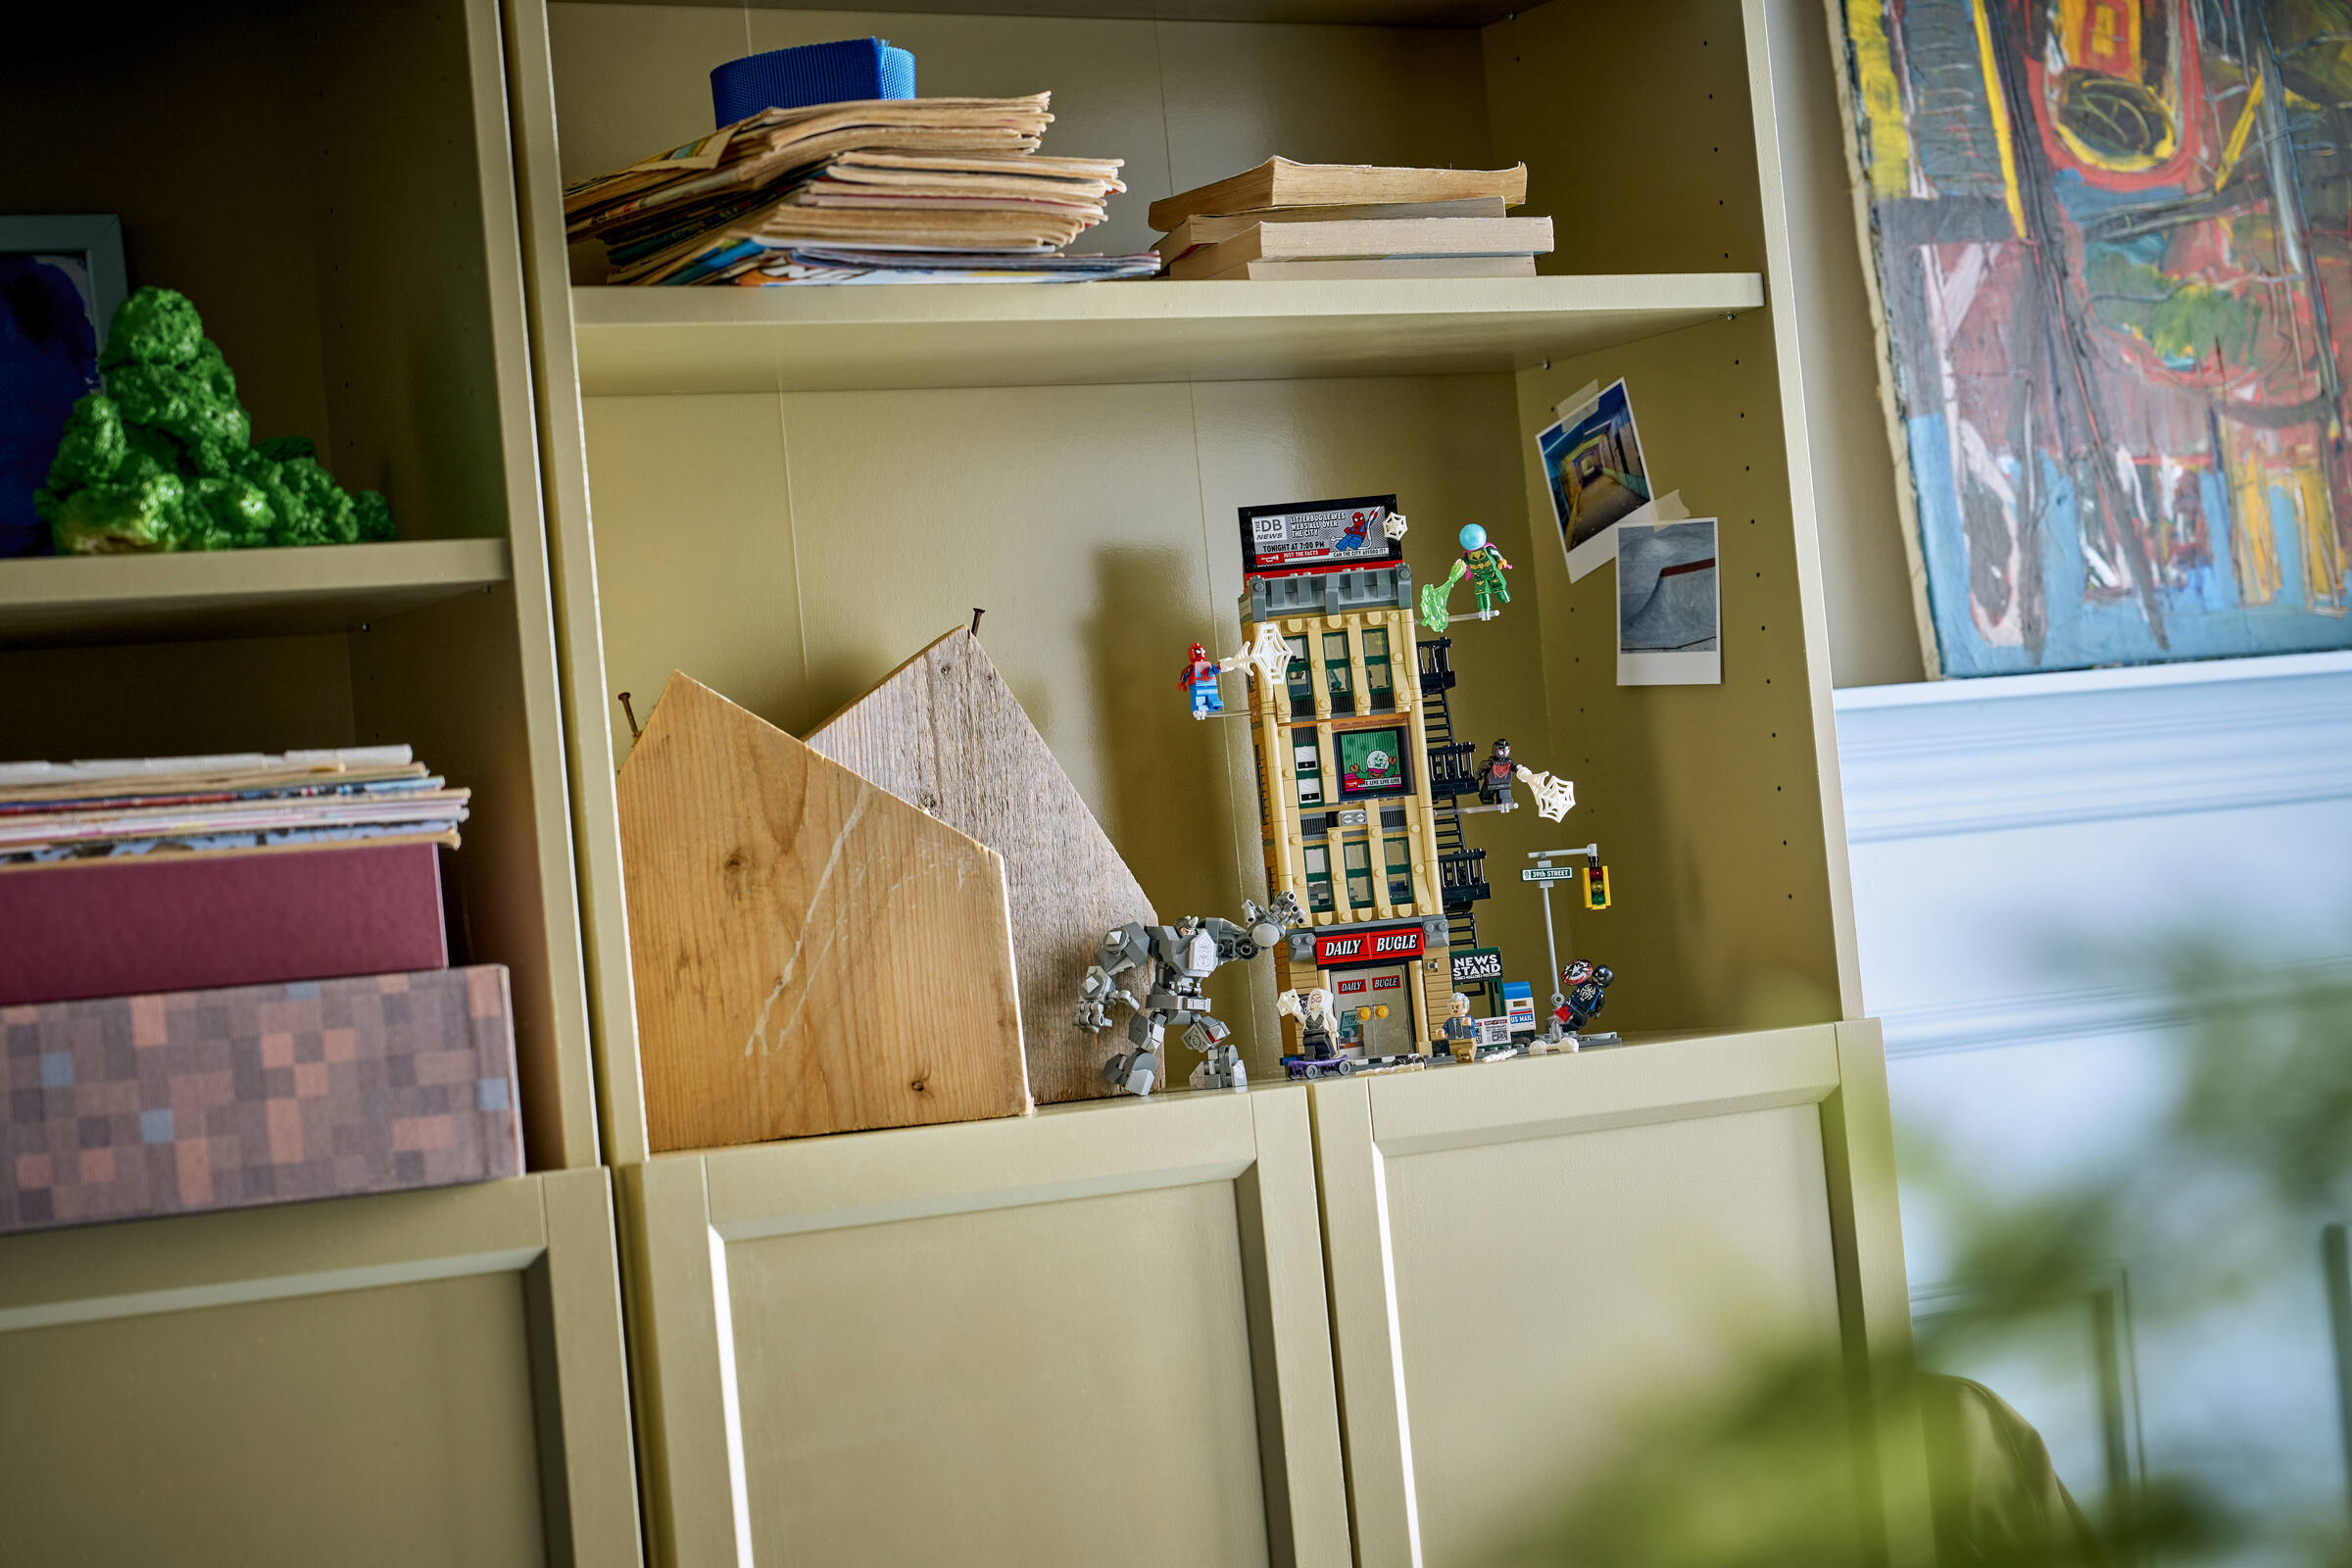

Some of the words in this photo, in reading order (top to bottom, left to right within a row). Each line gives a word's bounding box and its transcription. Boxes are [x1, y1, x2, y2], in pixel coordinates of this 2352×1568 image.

[1290, 514, 1323, 523] LITTERBUG
[1324, 512, 1346, 521] LEAVES
[1261, 518, 1282, 532] DB
[1304, 528, 1319, 537] CITY
[1263, 543, 1290, 553] TONIGHT
[1291, 542, 1299, 551] AT
[1300, 541, 1313, 550] 7:00
[1325, 939, 1363, 956] DAILY
[1376, 934, 1418, 953] BUGLE
[1454, 955, 1497, 967] NEWS
[1453, 963, 1500, 976] STAND
[1342, 982, 1362, 992] DAILY
[1375, 978, 1397, 988] BUGLE
